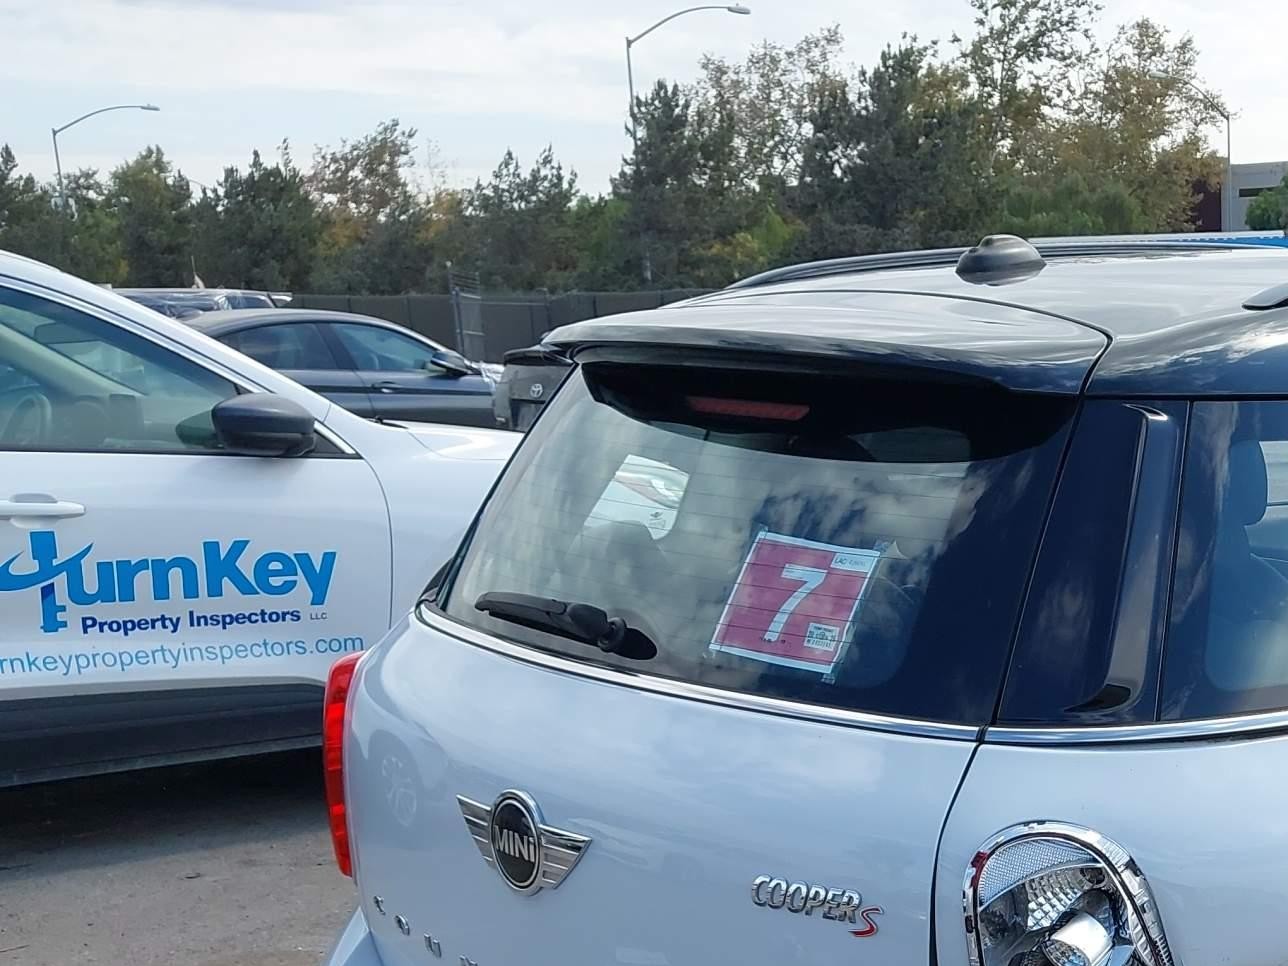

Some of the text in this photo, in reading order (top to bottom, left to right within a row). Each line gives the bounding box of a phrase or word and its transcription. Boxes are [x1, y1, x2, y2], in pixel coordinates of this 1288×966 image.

[81, 608, 328, 636] Property Inspectors LLC
[763, 564, 829, 642] 7
[751, 874, 885, 938] COOPER S
